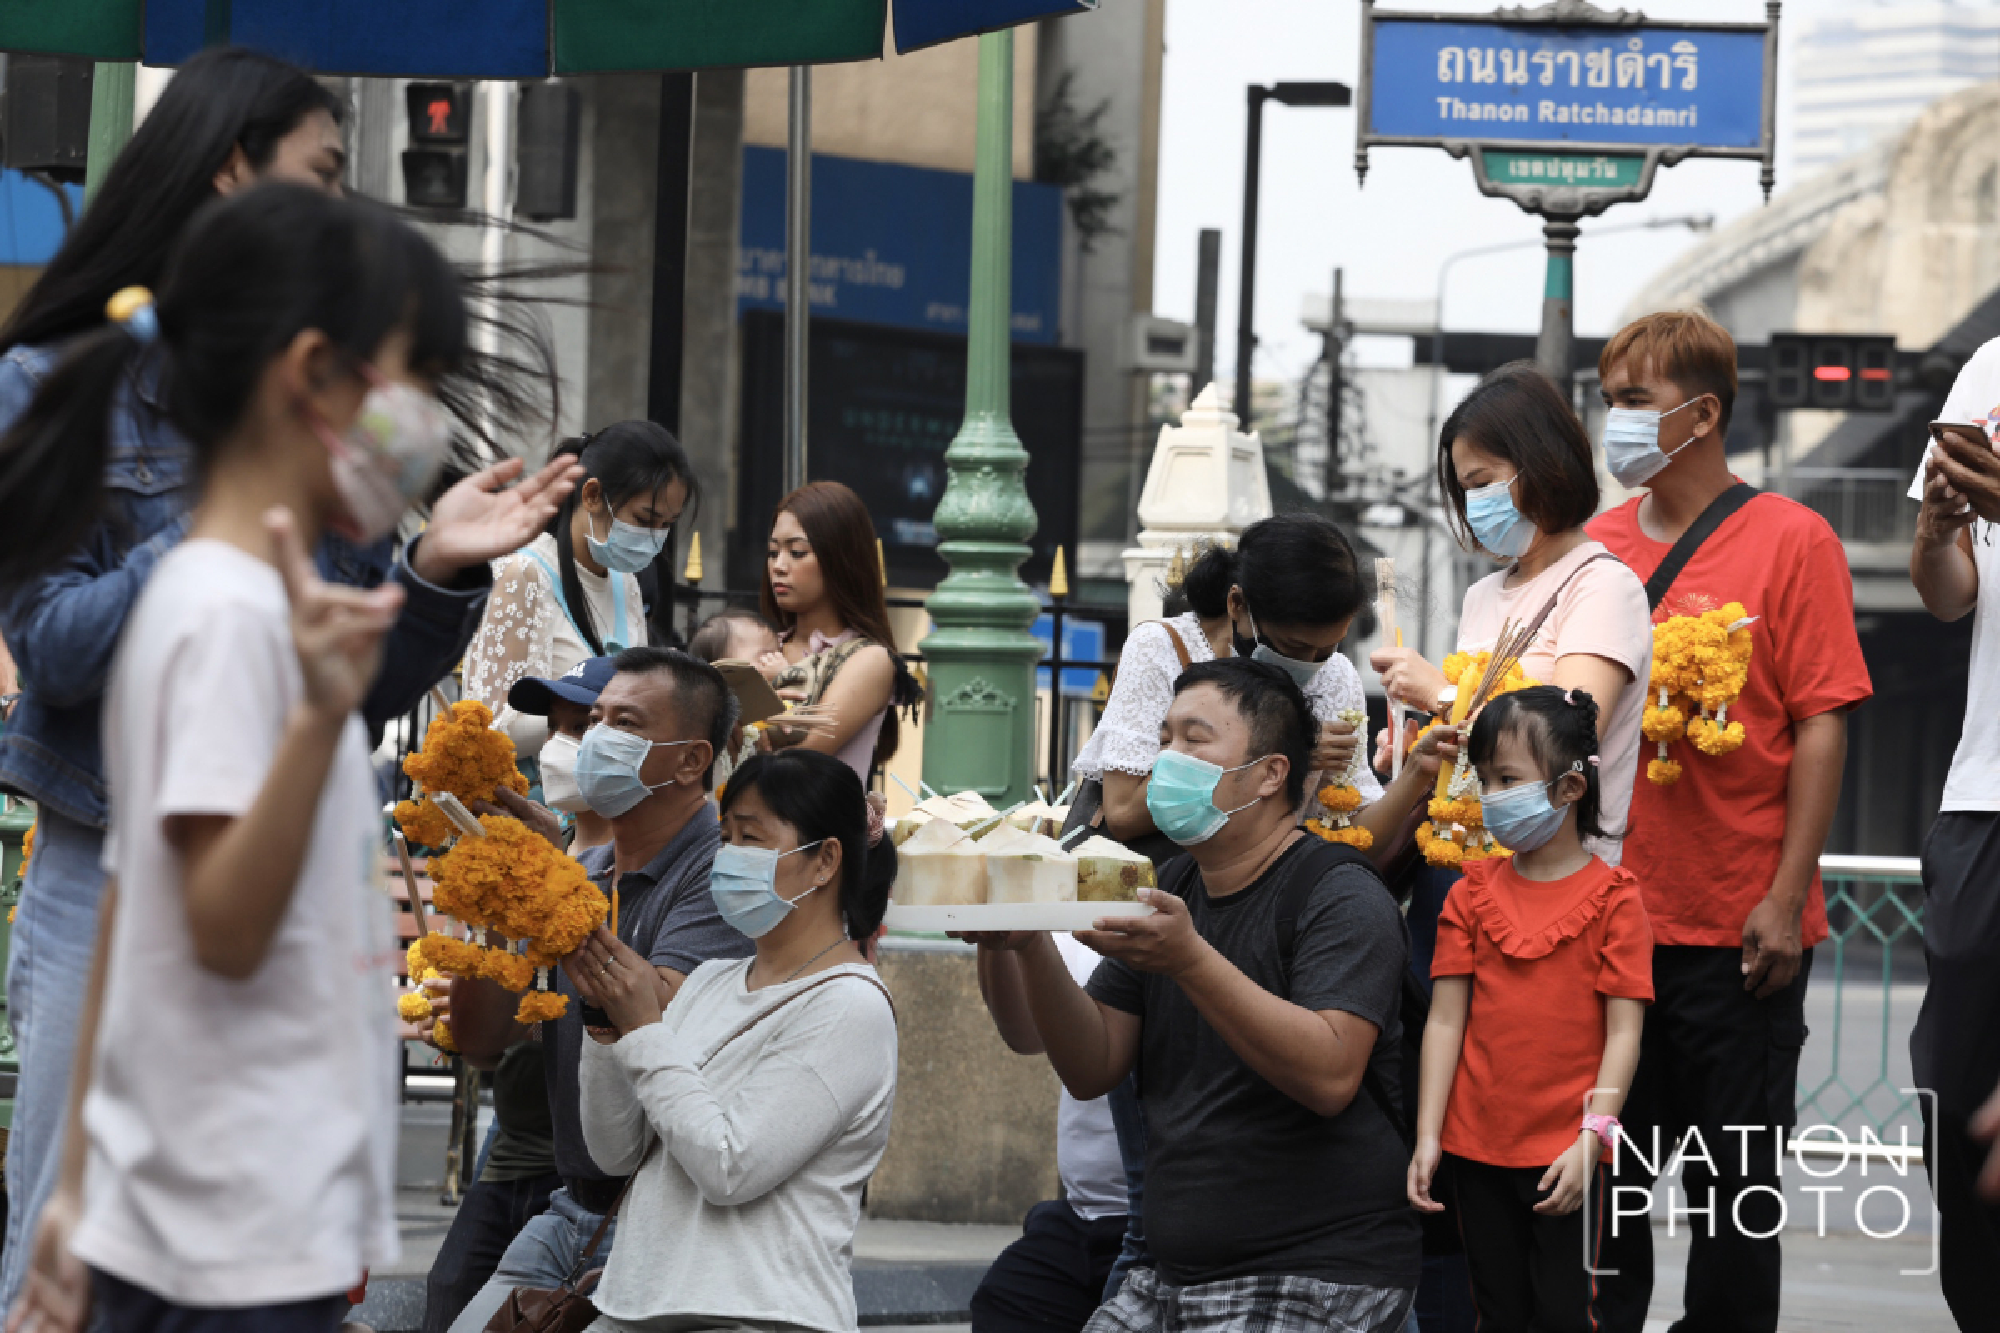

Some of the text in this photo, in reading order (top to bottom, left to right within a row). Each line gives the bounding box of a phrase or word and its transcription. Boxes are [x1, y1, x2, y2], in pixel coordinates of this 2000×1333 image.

[1437, 37, 1698, 90] ถนนราชดำริ
[1436, 97, 1698, 127] Thanon Ratchadamri
[1508, 156, 1618, 183] เขตปทุมวัน
